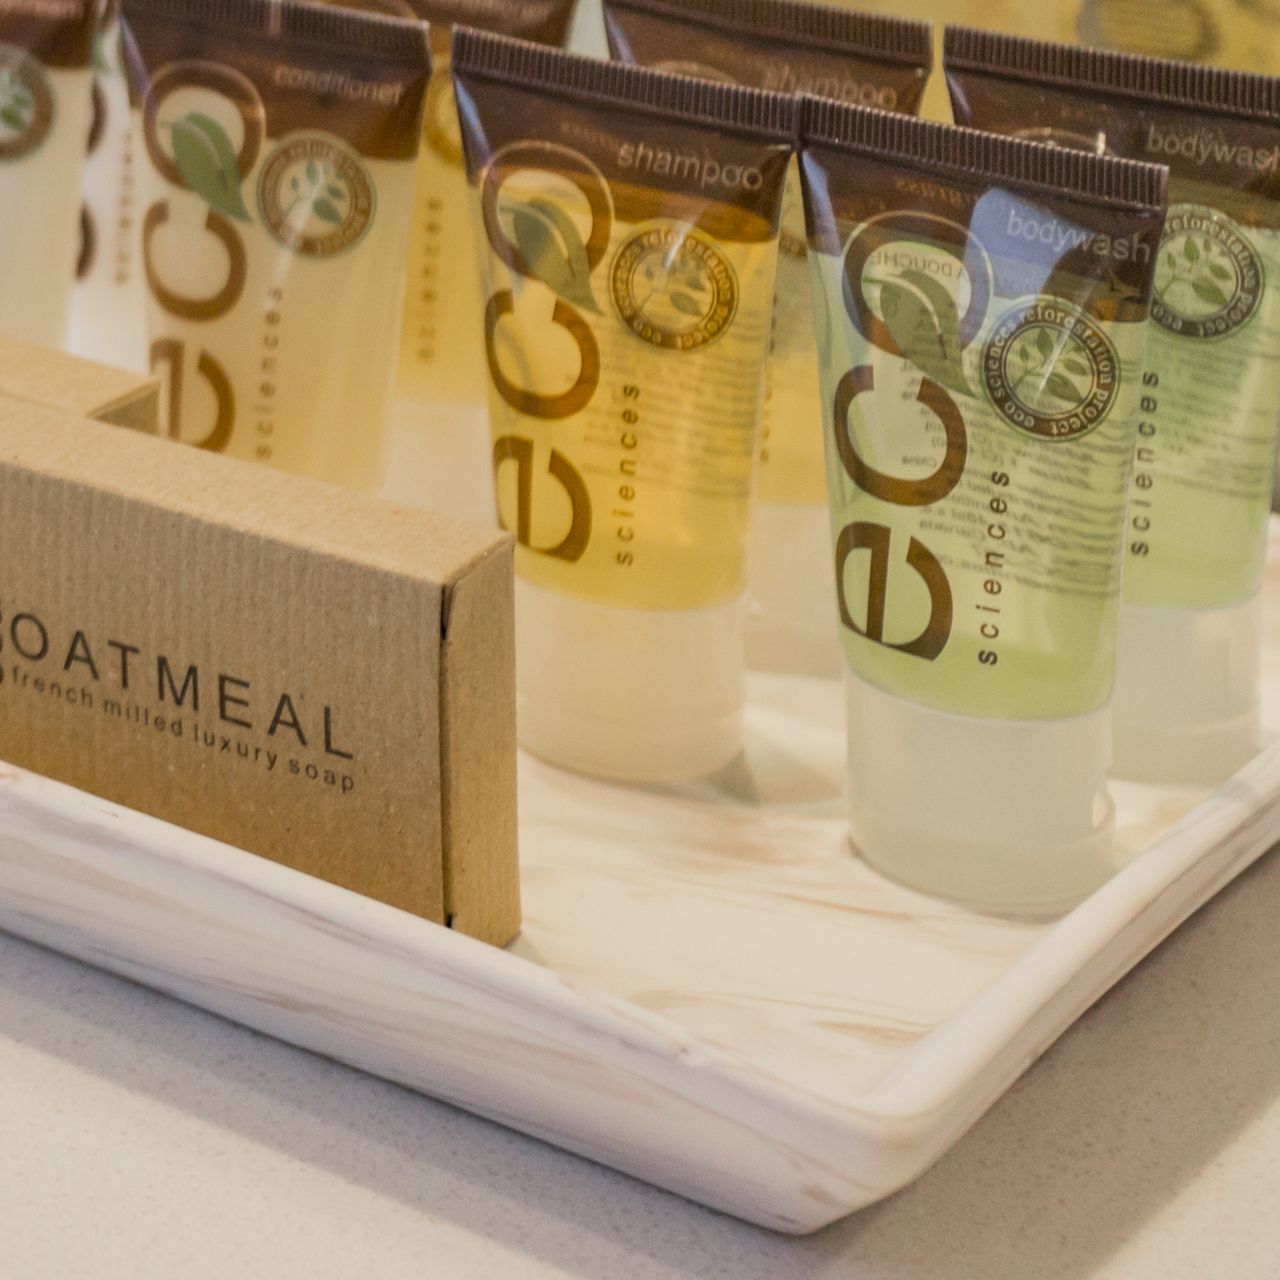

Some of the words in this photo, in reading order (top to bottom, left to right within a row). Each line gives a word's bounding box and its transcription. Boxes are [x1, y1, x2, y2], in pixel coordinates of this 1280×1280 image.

[617, 140, 764, 191] shampoo
[1006, 209, 1151, 265] bodywash
[254, 287, 284, 461] sciences
[481, 140, 613, 564] eco
[1004, 401, 1035, 429] eco
[1019, 305, 1112, 384] reforestation
[1050, 388, 1109, 435] project
[615, 384, 641, 566] sciences
[832, 209, 992, 662] eco
[1130, 371, 1159, 557] sciences
[978, 470, 1010, 666] sciences
[9, 611, 355, 761] OATMEAL
[11, 665, 94, 709] french
[103, 698, 184, 738] milled
[193, 722, 279, 771] luxury
[288, 757, 355, 794] soap
